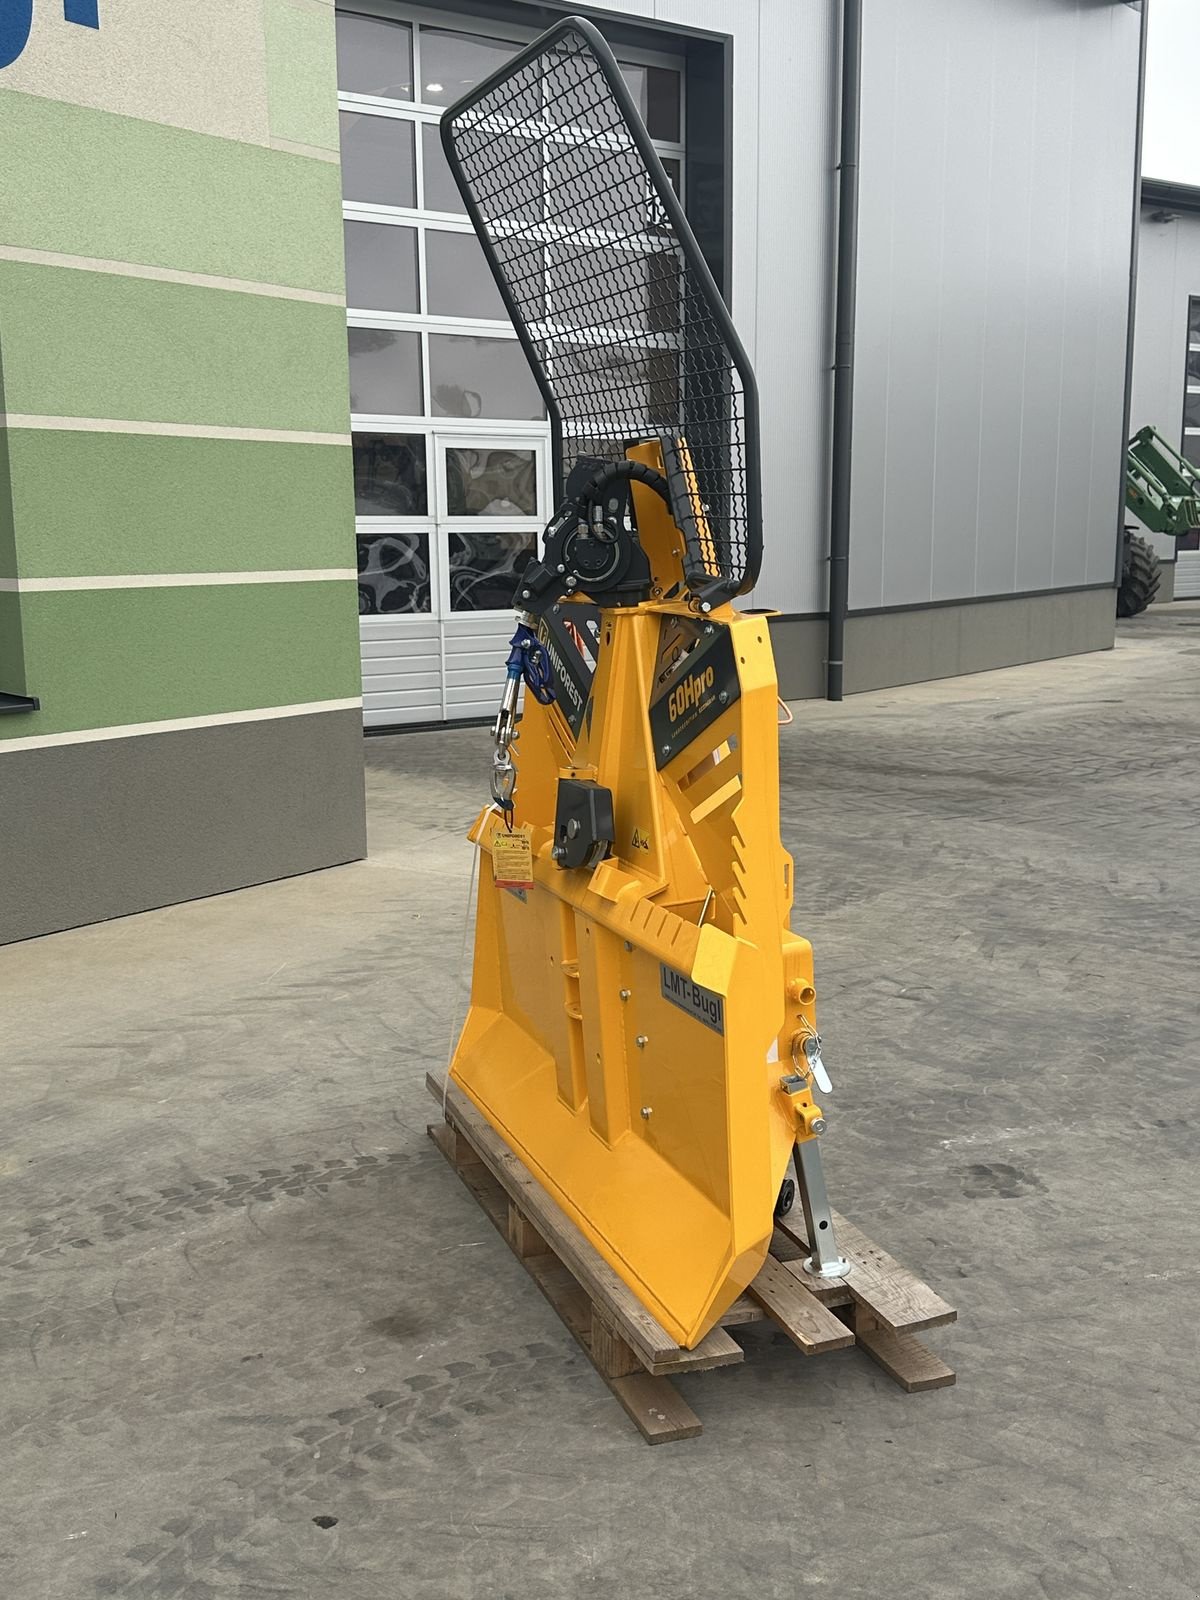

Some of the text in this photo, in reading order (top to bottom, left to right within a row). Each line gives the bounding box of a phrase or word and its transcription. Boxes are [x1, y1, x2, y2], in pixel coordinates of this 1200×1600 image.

[546, 640, 583, 712] UNIFOREST
[668, 666, 714, 722] 60Hpro
[663, 967, 721, 1024] LMT-Bugl
